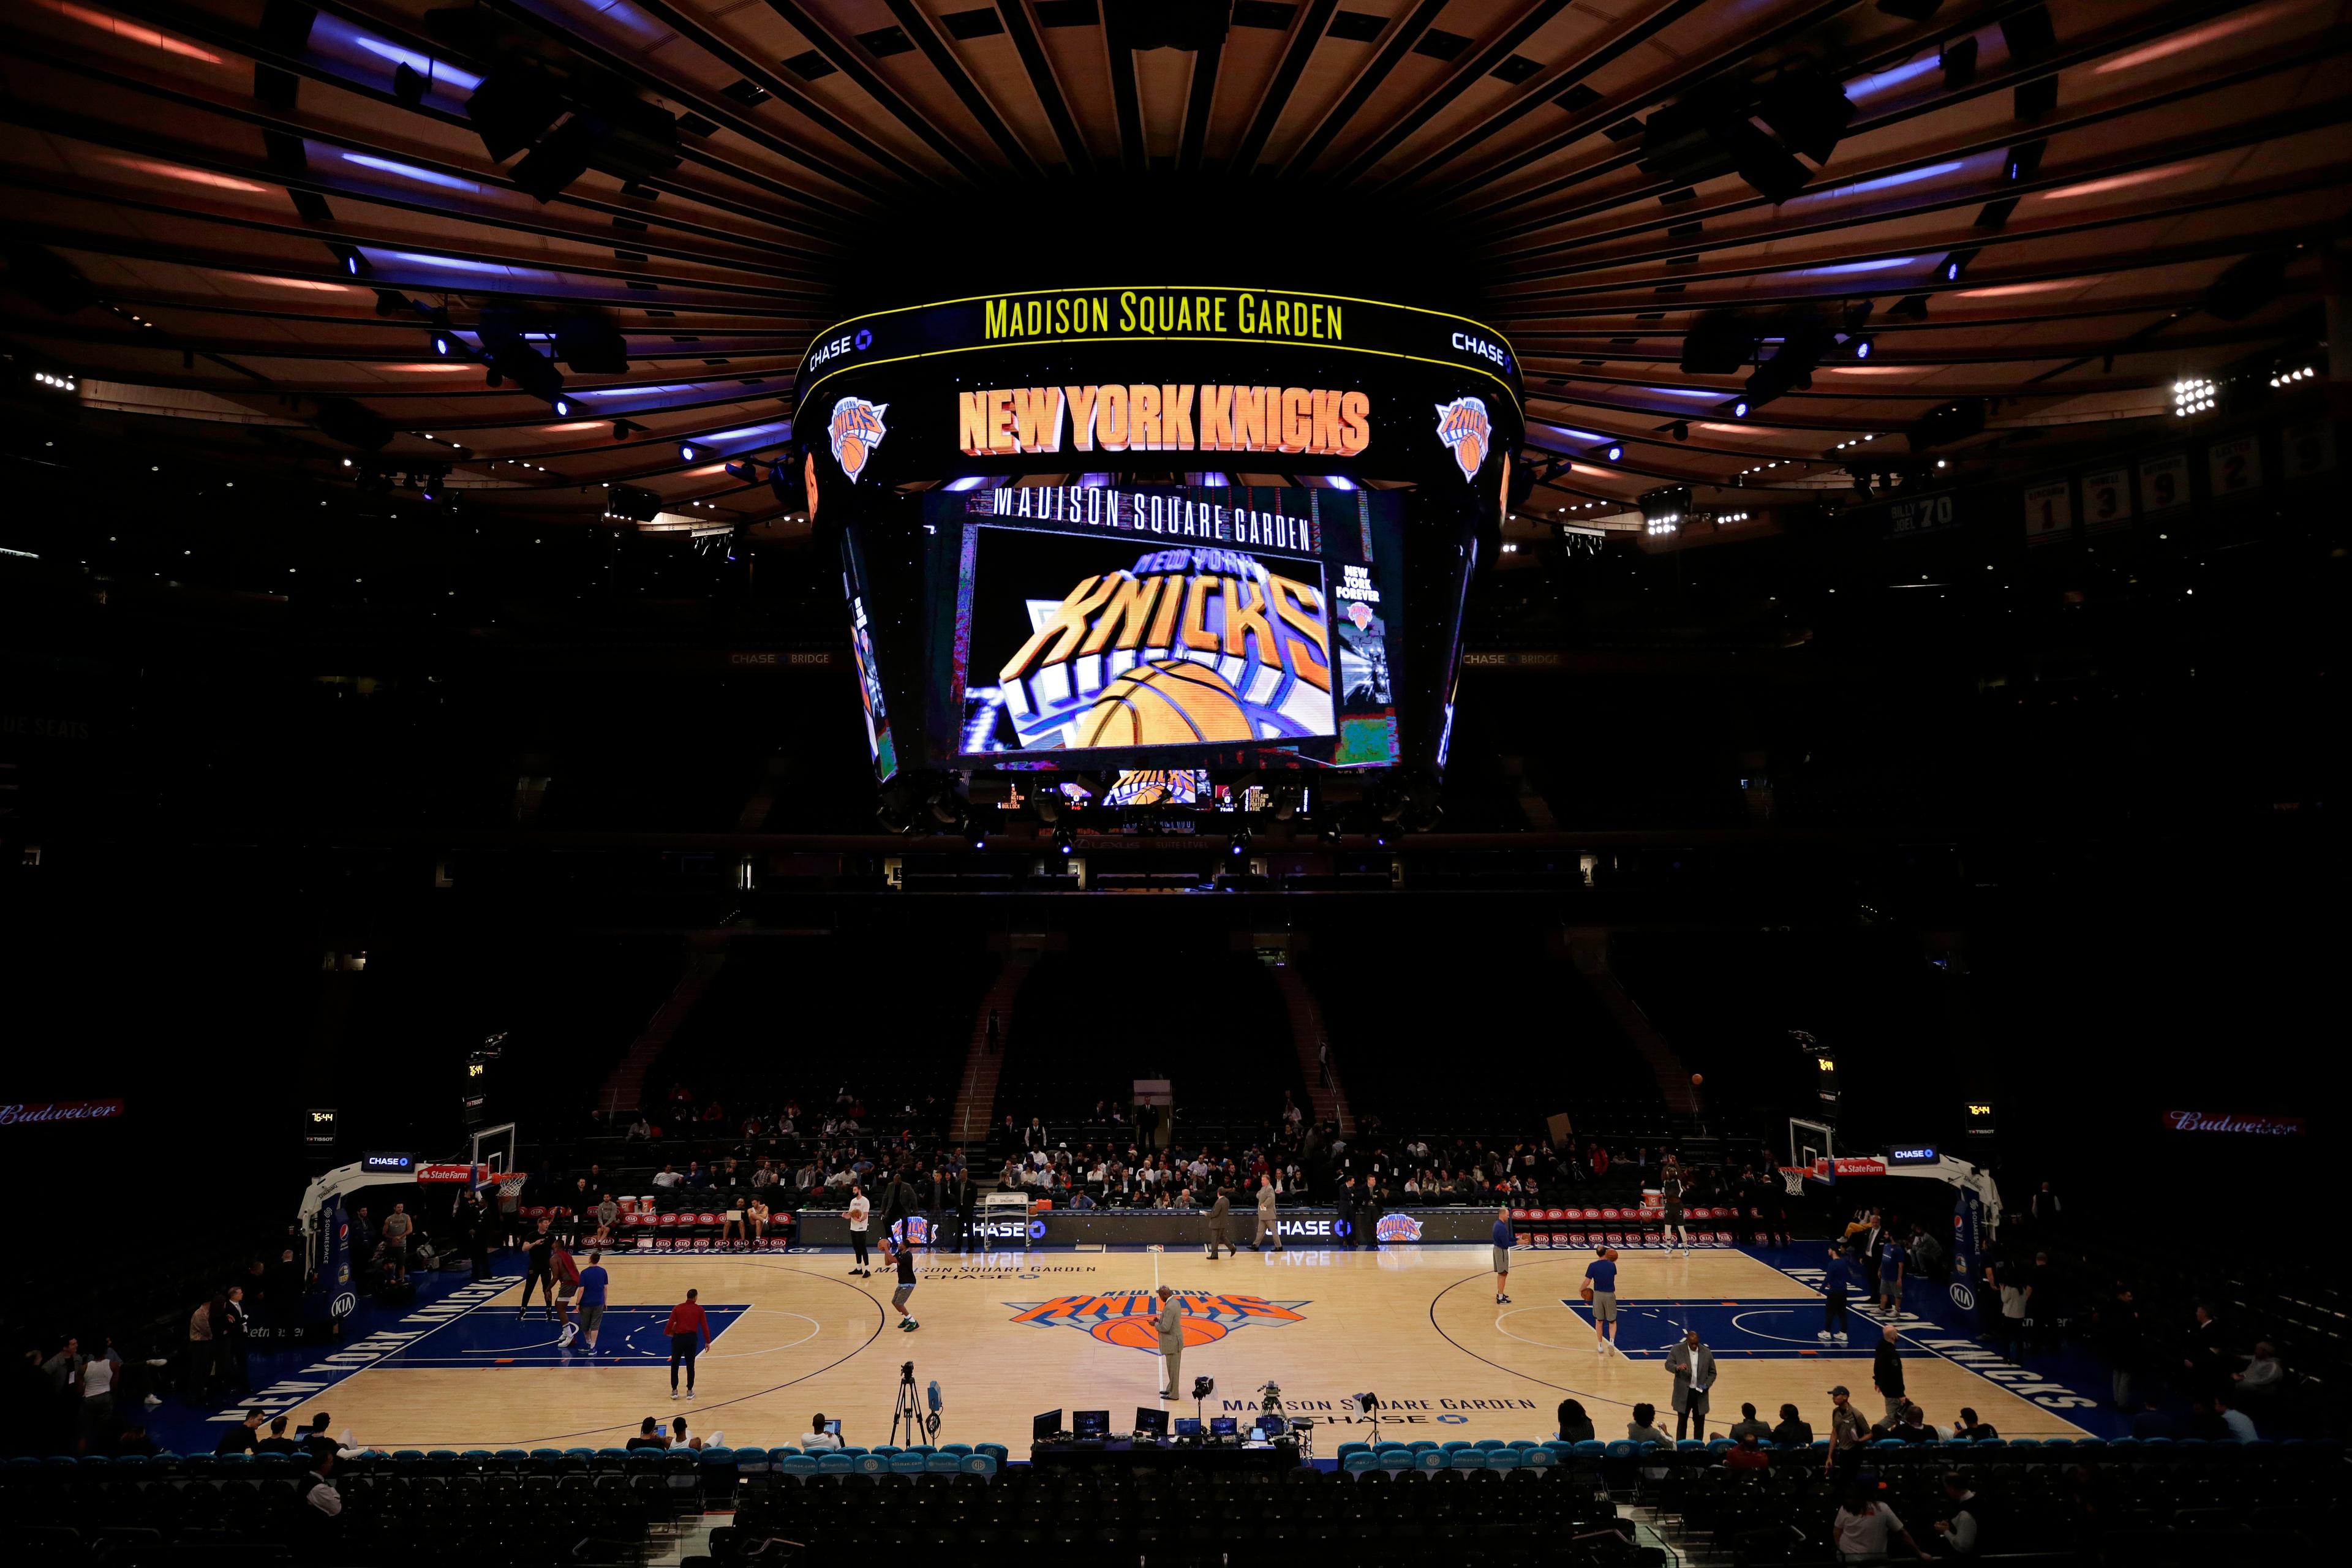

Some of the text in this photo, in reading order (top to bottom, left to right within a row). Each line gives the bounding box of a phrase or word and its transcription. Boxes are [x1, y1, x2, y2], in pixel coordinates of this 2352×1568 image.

[985, 291, 1343, 341] MADISON SQUARE GARDEN
[810, 335, 851, 372] CHASE
[1452, 332, 1504, 366] CHASE
[959, 384, 1370, 456] NEW YORK KNICKS
[1891, 503, 1916, 519] BILLY
[1920, 496, 1953, 528] 70
[2097, 488, 2116, 518] 3
[993, 486, 1310, 551] MADISON SQUARE GARDEN
[1893, 518, 1917, 532] JOEL
[2041, 500, 2055, 530] 1
[1133, 551, 1192, 573] NEW
[1344, 565, 1368, 579] NEW
[1336, 586, 1380, 602] FOREVER
[1343, 576, 1371, 590] YORK
[999, 571, 1332, 690] KNICKS
[732, 654, 829, 663] CHASE BRIDGE
[1463, 655, 1558, 664] CHASE BRIDGE
[0, 715, 89, 740] UE SEATS
[0, 1103, 116, 1125] Budweiser
[312, 1113, 333, 1121] 76:44
[2170, 1110, 2297, 1134] Budweiser
[1894, 1150, 1924, 1159] CHASE
[962, 1223, 1025, 1237] HASE
[1377, 1219, 1419, 1234] KNICKS
[336, 1297, 352, 1315] KIA
[1953, 1286, 1970, 1307] KIA
[207, 1275, 525, 1421] NEW YORK KNICKS
[1919, 1339, 2098, 1409] KNICKS
[1223, 1398, 1537, 1411] MASON SUARE GARDEN
